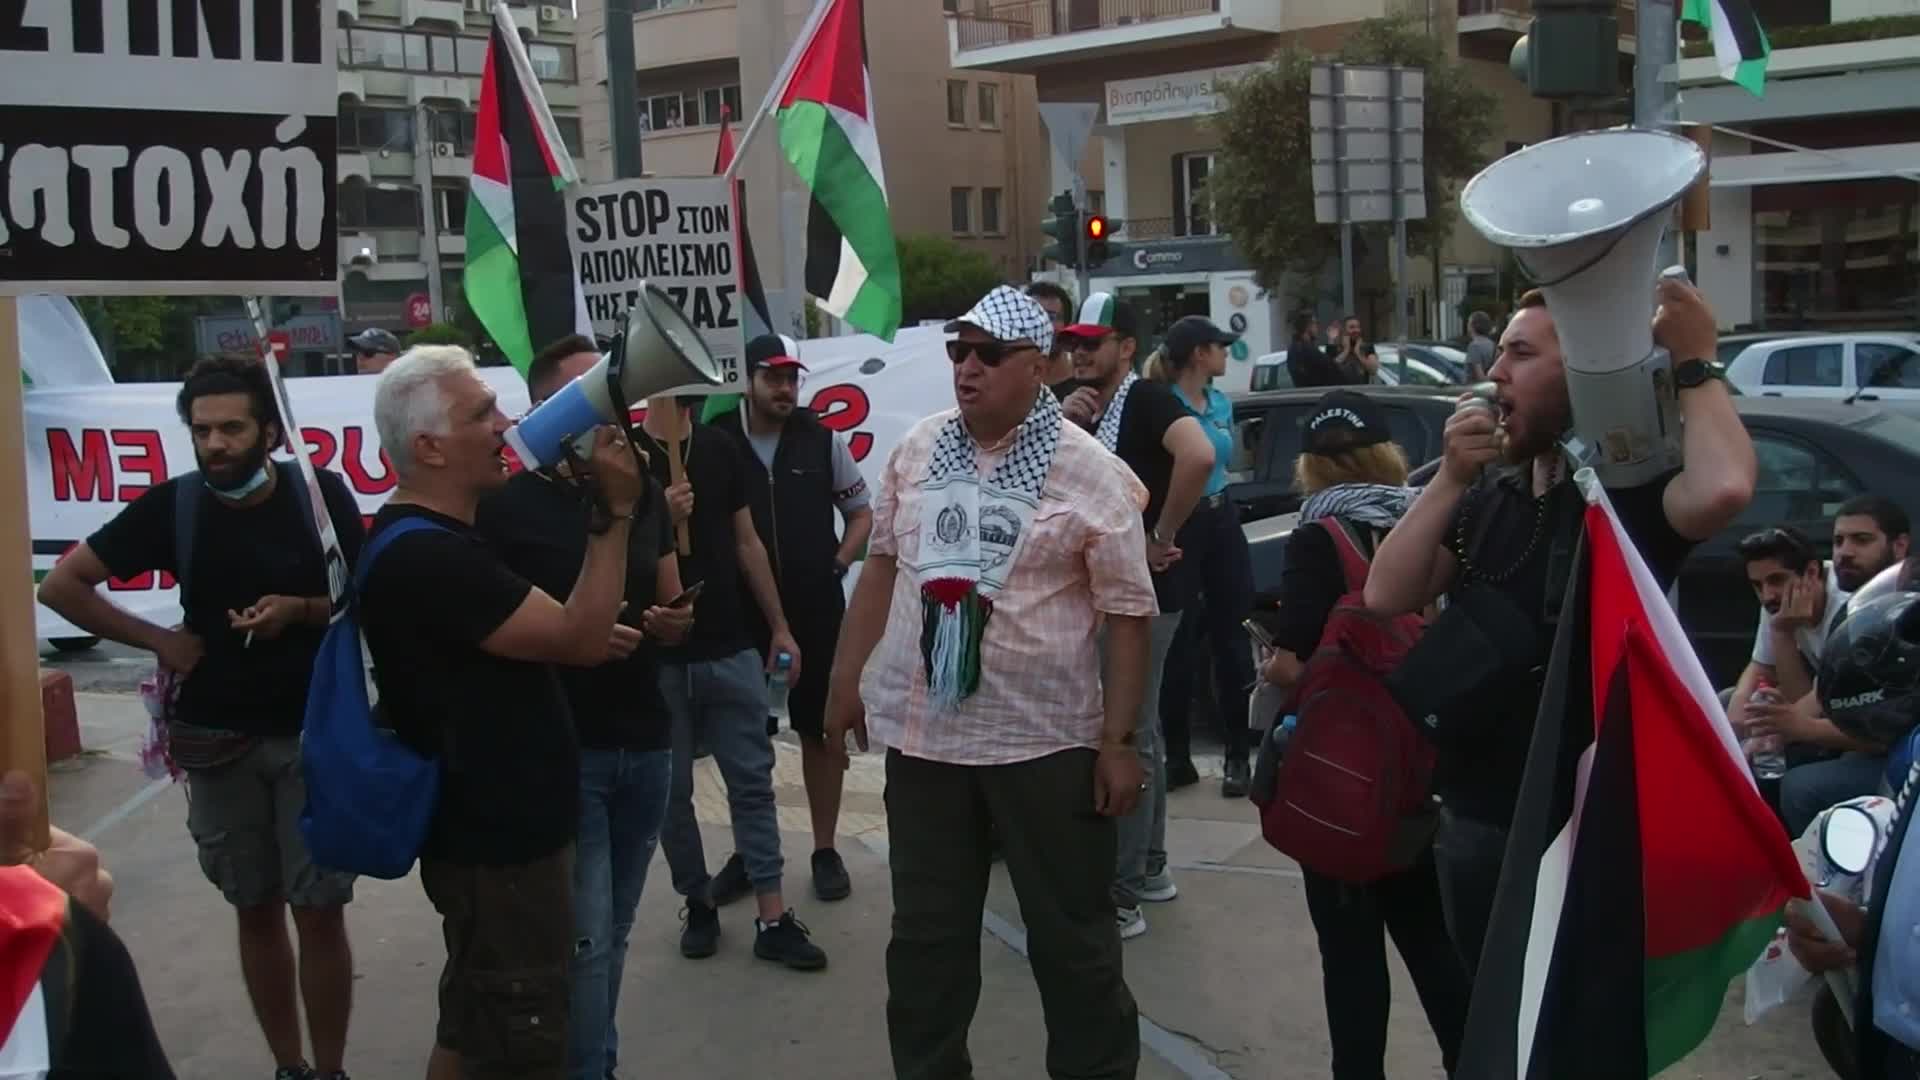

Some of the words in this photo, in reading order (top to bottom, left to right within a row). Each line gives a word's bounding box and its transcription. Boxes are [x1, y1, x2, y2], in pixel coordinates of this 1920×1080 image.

[0, 114, 325, 250] ατοχή
[575, 189, 670, 243] STOP
[677, 204, 730, 234] ΣΤΟΝ
[580, 242, 732, 284] ΑΠΟΚΛΕΙΣΜΟ
[1311, 408, 1365, 430] PALESTINE
[1830, 688, 1884, 709] SHARK
